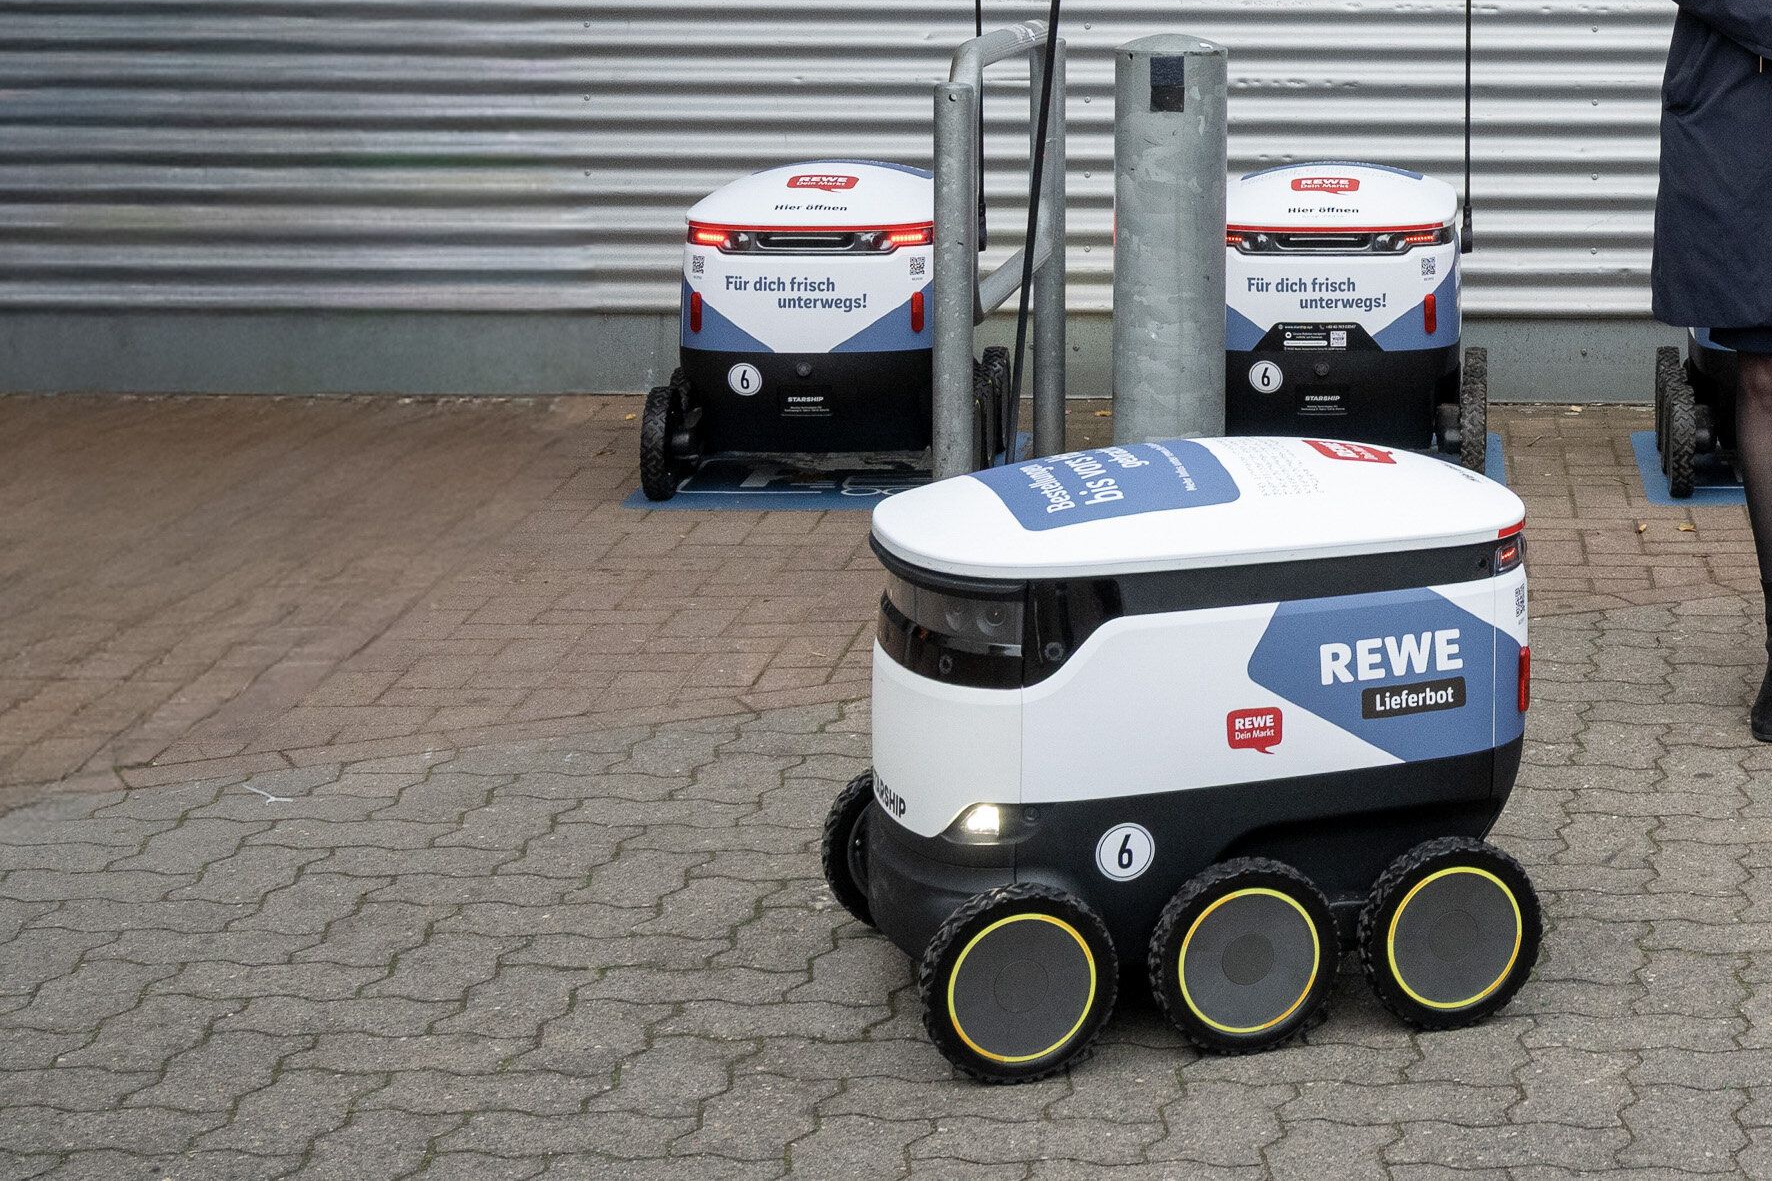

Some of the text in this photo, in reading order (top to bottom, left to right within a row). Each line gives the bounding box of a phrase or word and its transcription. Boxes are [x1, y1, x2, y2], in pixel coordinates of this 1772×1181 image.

[805, 204, 848, 212] öffnen
[1318, 206, 1359, 214] öffnen
[725, 275, 836, 292] Für dich frisch
[1246, 277, 1356, 293] Für dich frisch
[777, 293, 868, 311] unterwegs!
[1299, 293, 1387, 312] unterwegs!
[740, 370, 750, 390] 6
[1261, 367, 1271, 387] 6
[1064, 456, 1107, 479] vors
[1020, 464, 1076, 514] Bestellungen
[1079, 478, 1125, 506] bis
[1319, 628, 1464, 686] REWE
[1375, 686, 1455, 712] Lieferbot
[1234, 715, 1275, 731] REWE
[1234, 728, 1275, 741] Dein Markt
[1117, 834, 1133, 869] 6
